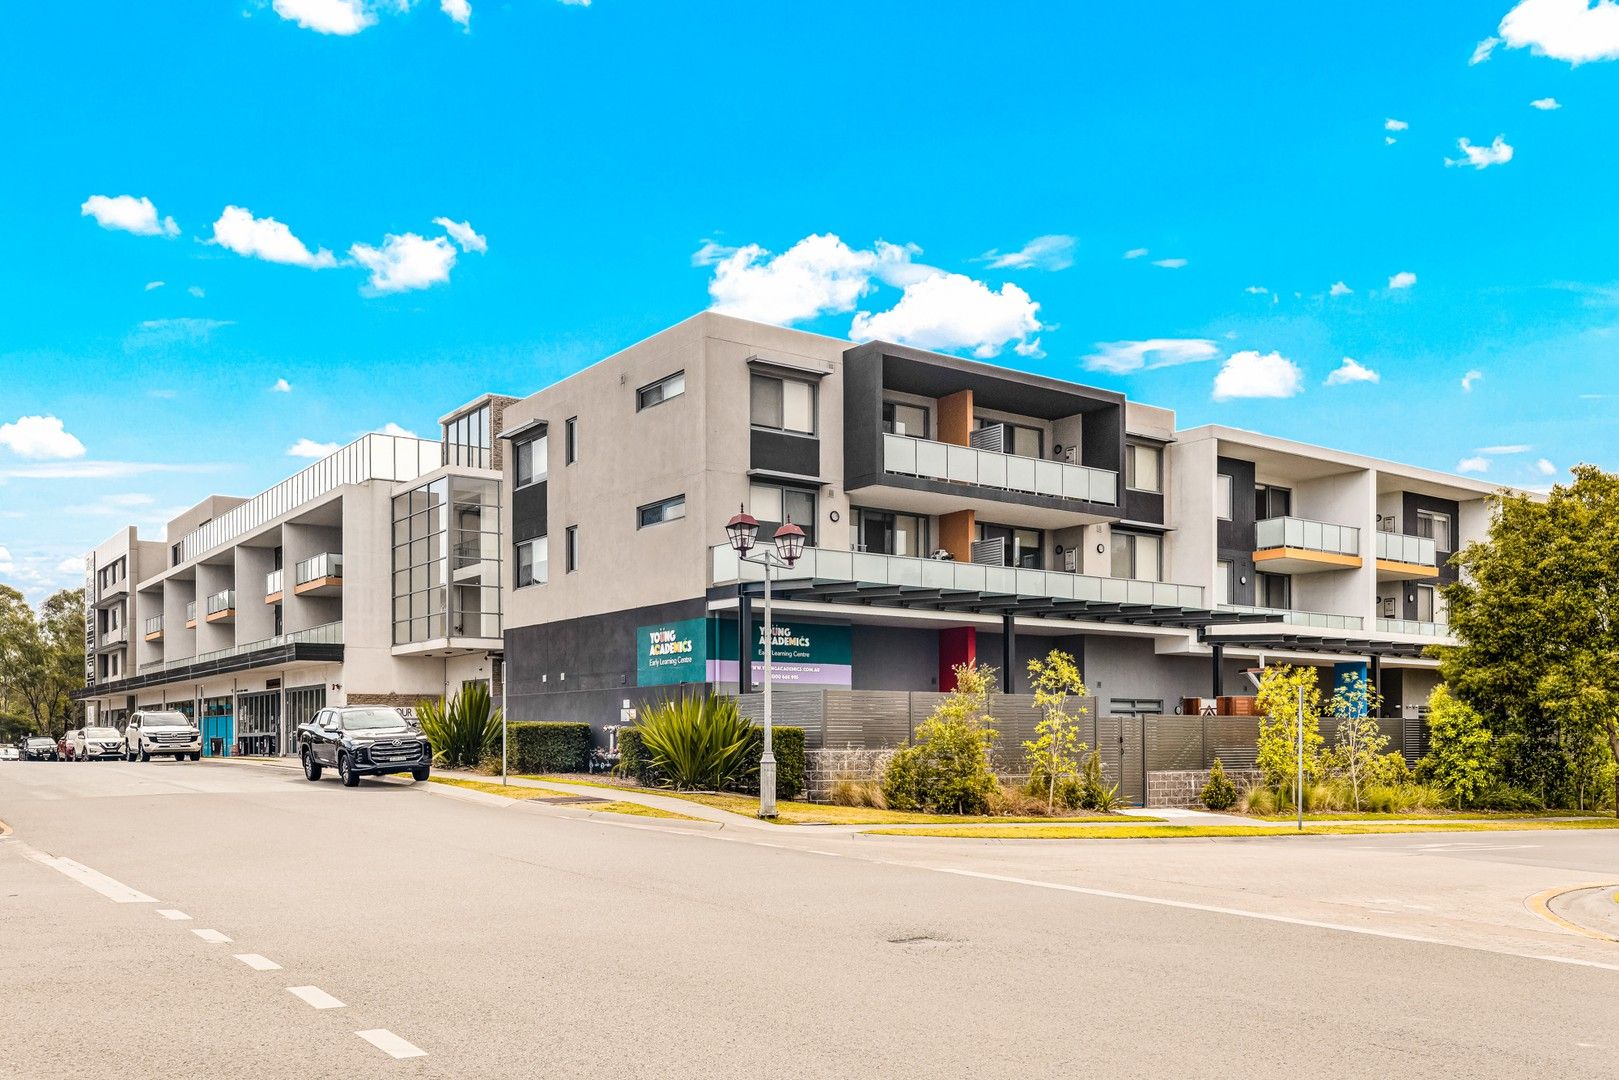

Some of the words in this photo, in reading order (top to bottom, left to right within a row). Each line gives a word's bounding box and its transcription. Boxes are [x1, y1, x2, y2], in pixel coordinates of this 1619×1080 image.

[771, 649, 793, 658] Learning
[649, 658, 659, 668] Early
[660, 657, 677, 666] Learning
[678, 656, 692, 664] Centre
